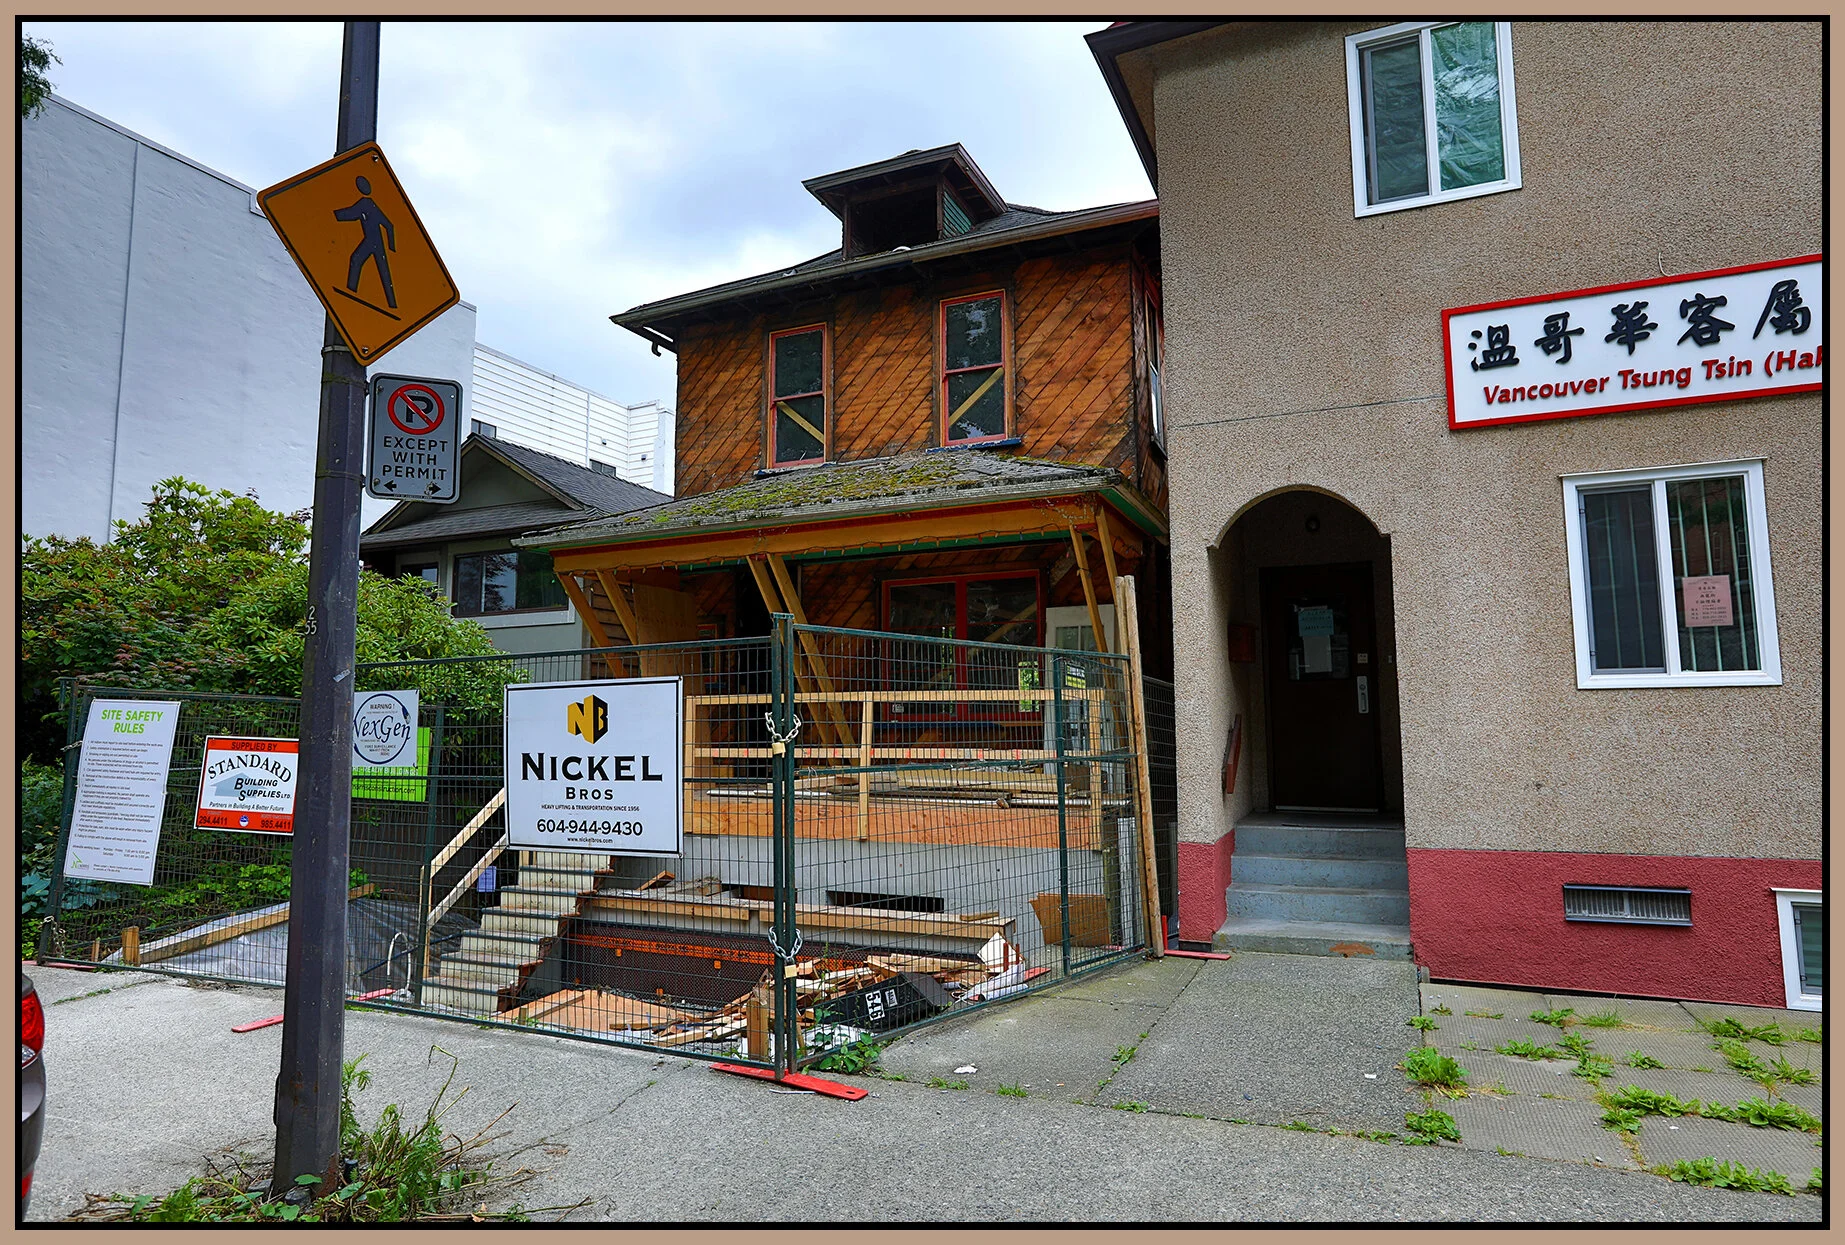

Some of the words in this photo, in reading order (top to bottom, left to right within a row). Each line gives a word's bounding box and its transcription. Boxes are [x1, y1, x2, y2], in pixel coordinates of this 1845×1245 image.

[1483, 375, 1610, 405] Vancouver
[1618, 365, 1692, 390] Tsung
[1701, 355, 1752, 380] Tsin
[383, 436, 448, 452] EXCEPT
[392, 451, 437, 465] WITH
[382, 465, 447, 480] PERMIT
[308, 605, 316, 619] 2
[101, 709, 123, 720] SITE
[125, 710, 163, 721] SAFETY
[113, 722, 145, 734] RULES
[231, 741, 266, 751] SUPPLIED
[267, 743, 278, 751] BY
[207, 754, 291, 783] STANDARD
[521, 752, 663, 782] NICKEL
[234, 777, 278, 790] BUILDING
[238, 789, 281, 801] SUPPLIES
[565, 787, 614, 800] BROS
[232, 802, 251, 811] Building
[269, 804, 284, 812] Future
[537, 819, 643, 836] 604-944-9430
[867, 991, 884, 1019] 546
